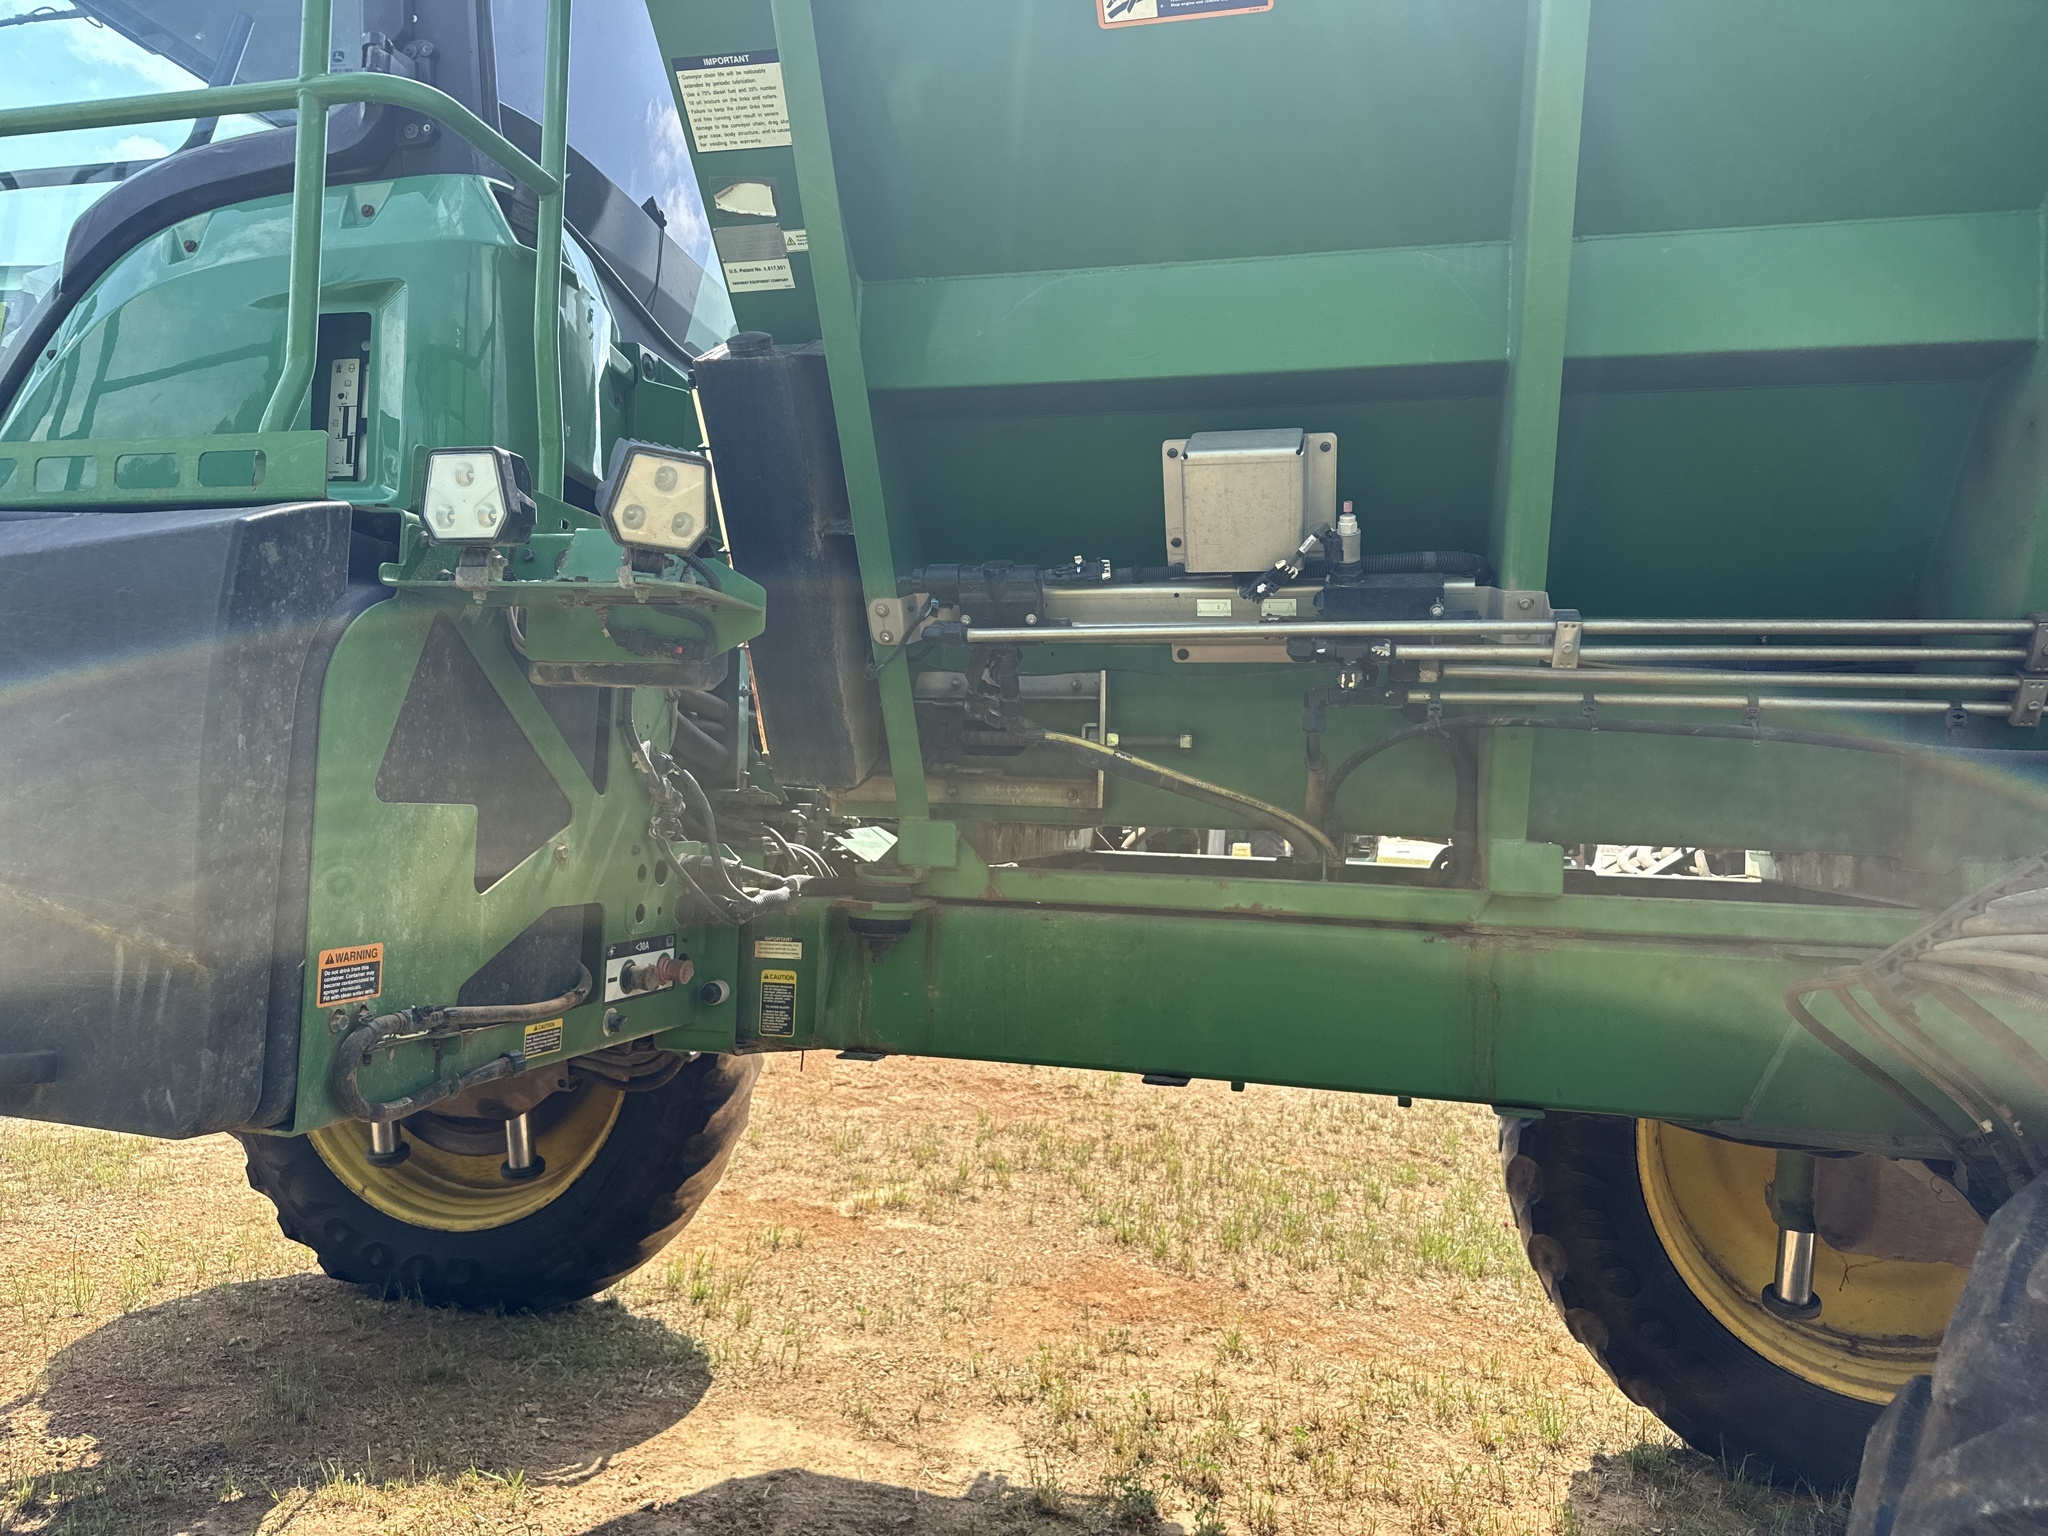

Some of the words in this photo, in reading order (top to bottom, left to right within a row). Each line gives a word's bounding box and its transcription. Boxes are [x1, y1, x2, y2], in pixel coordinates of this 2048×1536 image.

[702, 55, 749, 66] IMPORTANT
[1116, 752, 1132, 761] Parker
[335, 948, 378, 963] WARNING
[341, 978, 370, 986] contaminated
[323, 988, 340, 996] sprayer
[340, 984, 362, 992] chemicals.
[538, 1022, 555, 1030] CAUTION
